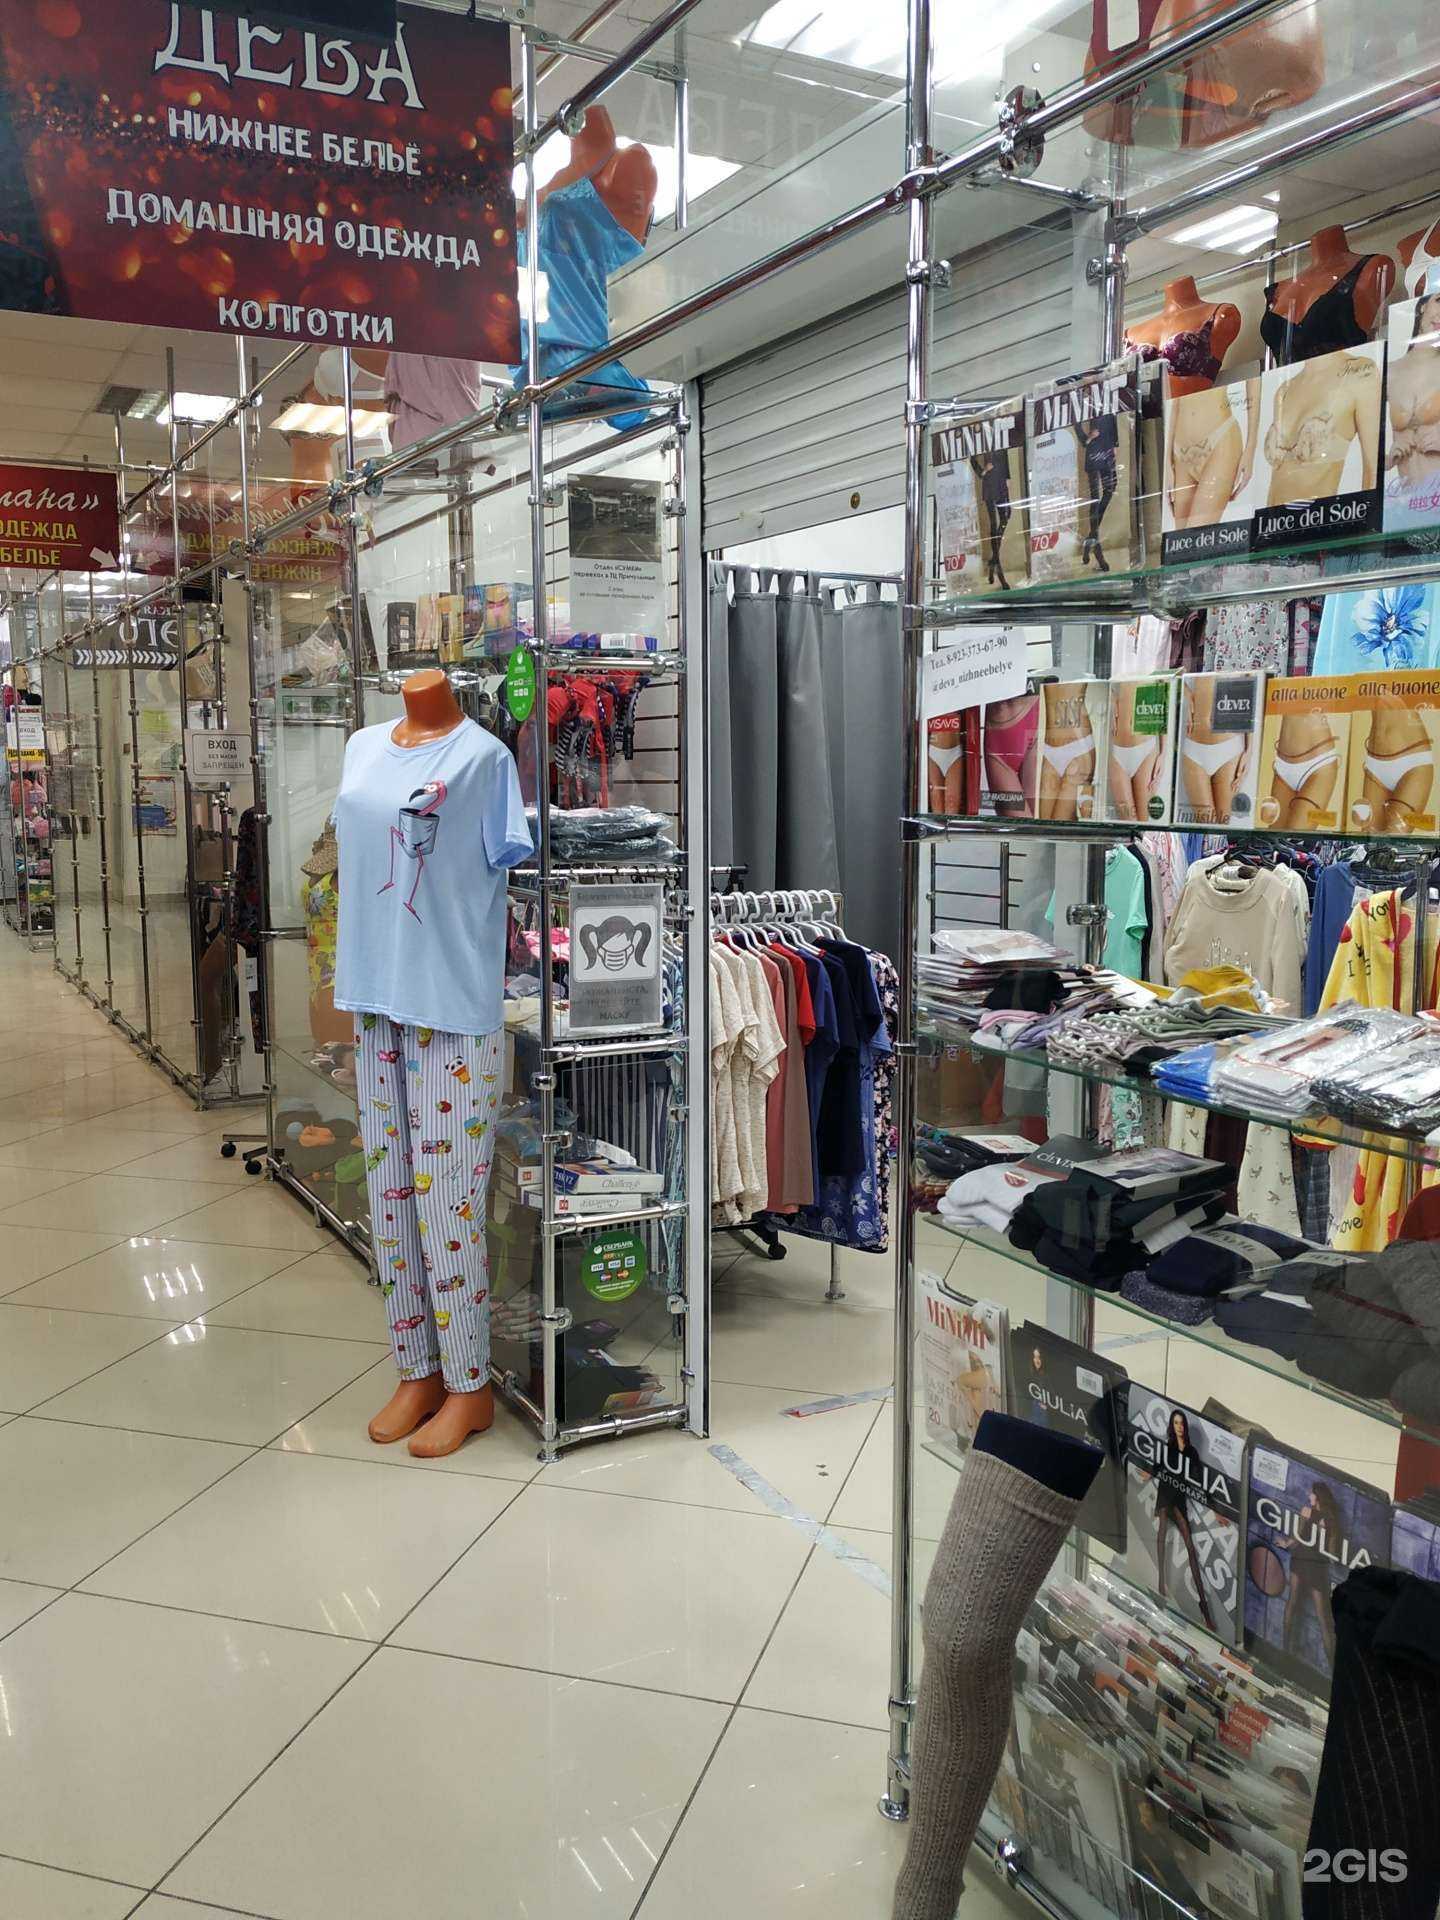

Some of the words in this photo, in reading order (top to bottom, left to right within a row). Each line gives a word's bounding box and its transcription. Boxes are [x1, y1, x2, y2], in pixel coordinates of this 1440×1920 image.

[168, 107, 312, 159] НИЖНЕЕ
[323, 132, 421, 176] БЕЛЬЁ
[107, 188, 324, 246] ДОМАШНЯЯ
[336, 220, 481, 269] ОДЕЖДА
[218, 296, 393, 344] КОЛГОТКИ
[1258, 513, 1295, 534] Luce
[1300, 507, 1324, 527] del
[1329, 502, 1367, 523] Sole
[1165, 535, 1193, 553] Luce
[1196, 532, 1215, 548] del
[1219, 528, 1248, 545] Sole
[0, 547, 61, 566] БЕЛЬЕ
[1272, 687, 1297, 701] alla
[1302, 686, 1347, 701] buone
[1358, 681, 1386, 696] alla
[1391, 680, 1440, 696] buone
[928, 717, 960, 730] VISAVIS
[208, 740, 237, 751] ВХОД
[202, 761, 245, 769] ЗАПРЕЩЕН
[1176, 807, 1231, 825] Invisible
[1156, 1471, 1208, 1504] AUTOGRAPH
